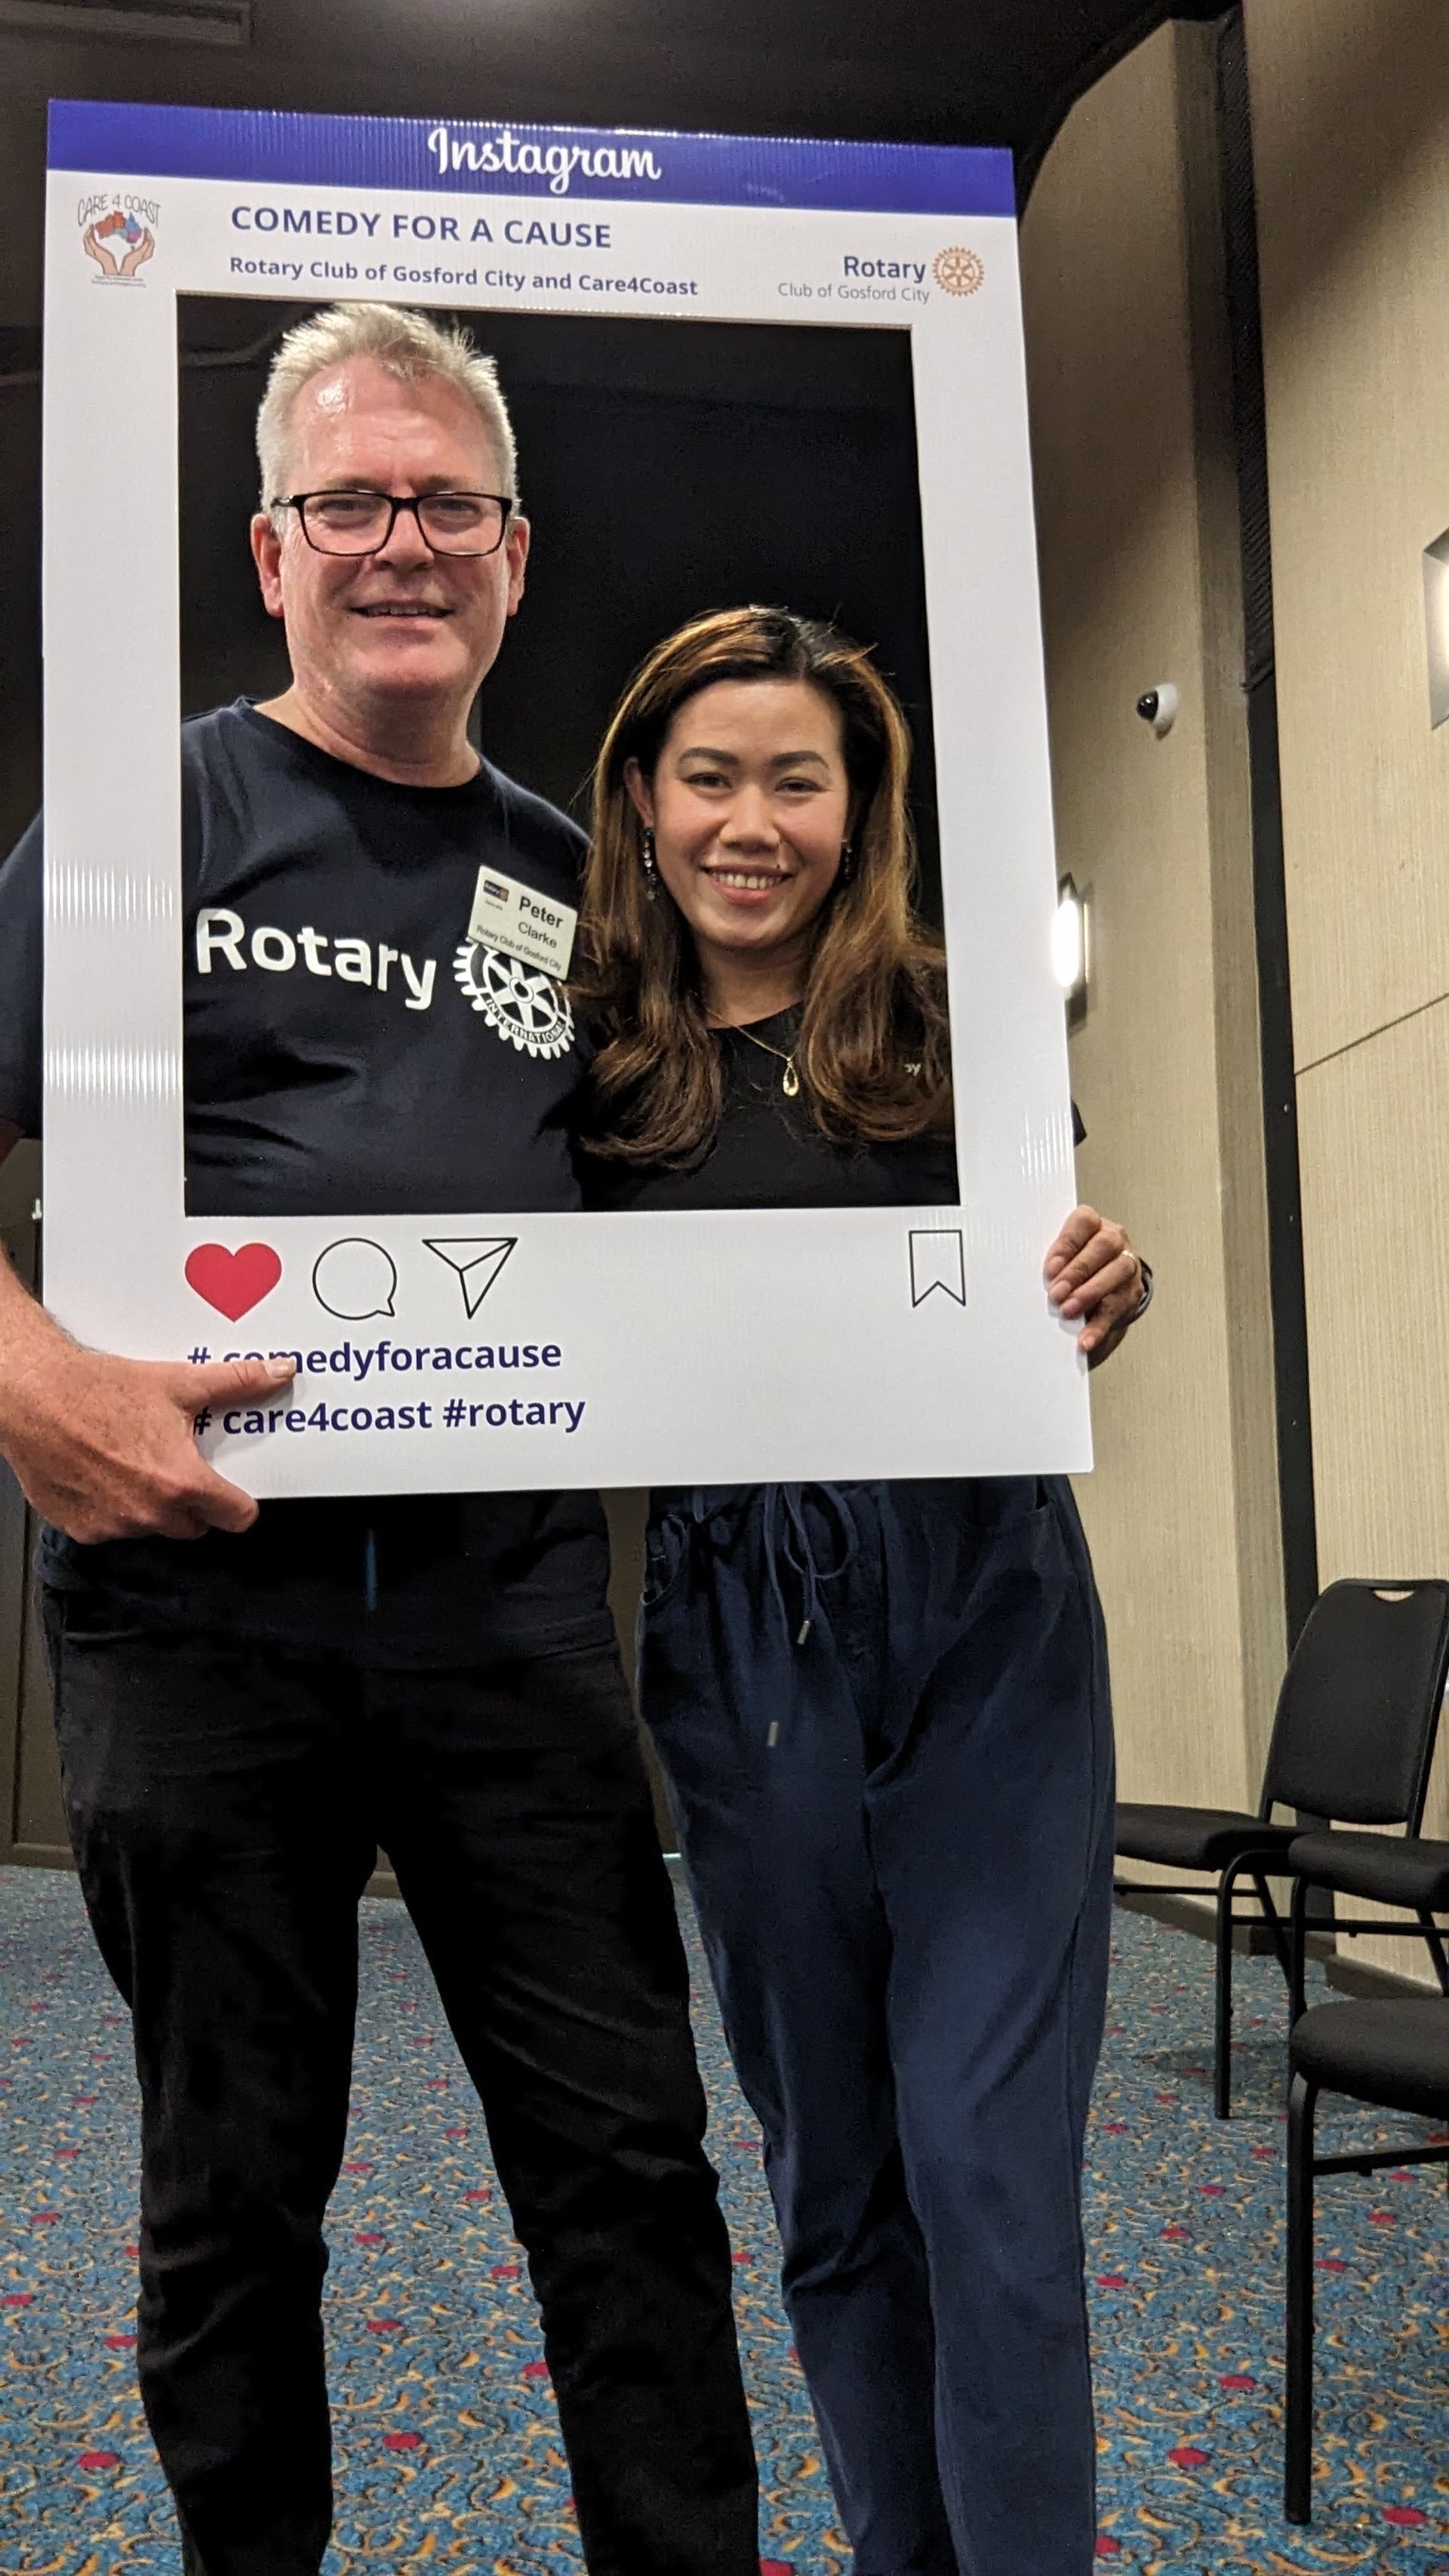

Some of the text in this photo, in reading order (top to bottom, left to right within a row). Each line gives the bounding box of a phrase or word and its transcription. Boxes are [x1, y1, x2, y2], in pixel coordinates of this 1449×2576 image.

[428, 127, 661, 194] Instagram
[77, 194, 161, 228] CARE 4 COAST
[231, 206, 612, 249] COMEDY FOR A CAUSE
[229, 257, 698, 296] Rotary Club of Gosford City and Care4Coast
[843, 255, 926, 283] Rotary
[777, 282, 930, 304] Club of Gosford City
[518, 895, 564, 929] Peter
[476, 925, 562, 971] Rotary Club of Gosford City
[518, 921, 558, 949] Clarke
[196, 908, 436, 1011] Rotary
[486, 999, 566, 1043] INTERNATIONAL
[223, 1402, 432, 1435] care4coast
[442, 1398, 586, 1433] #rotary
